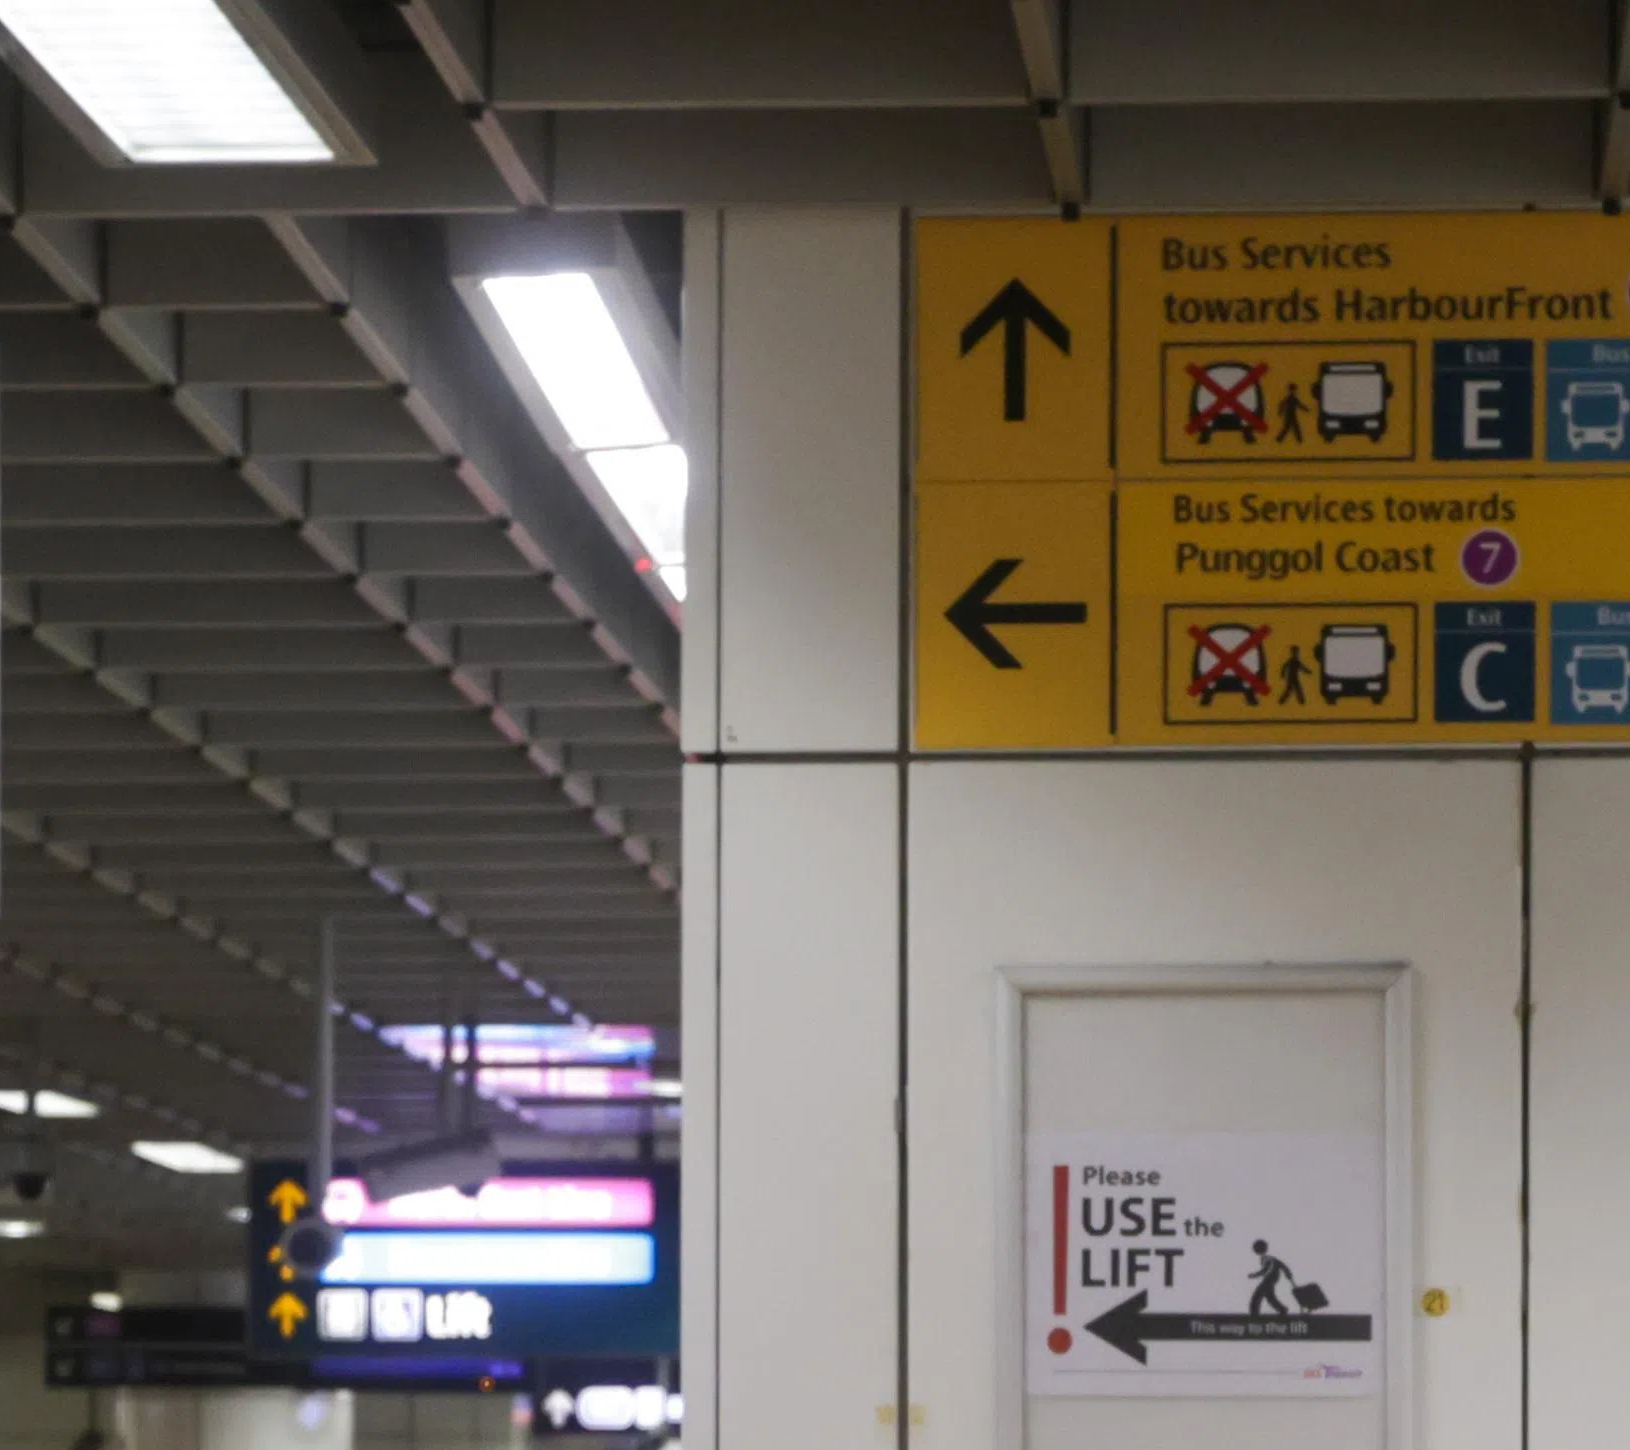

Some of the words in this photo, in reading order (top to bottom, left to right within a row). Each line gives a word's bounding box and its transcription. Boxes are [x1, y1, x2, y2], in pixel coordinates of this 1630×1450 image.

[1161, 237, 1228, 271] Bus
[1240, 232, 1392, 270] Services
[1163, 286, 1321, 323] towards
[1334, 285, 1613, 322] HarbourFront
[1464, 343, 1500, 364] Exit
[1592, 344, 1630, 363] Bus
[1463, 380, 1502, 449] E
[1173, 495, 1231, 523] Bus
[1241, 493, 1375, 523] Services
[1384, 493, 1516, 523] towards
[1176, 541, 1323, 580] Punggol
[1335, 541, 1435, 573] Coast
[1479, 541, 1502, 575] 7
[1467, 607, 1502, 626] Exit
[1460, 641, 1507, 712] C
[1082, 1165, 1161, 1186] Please
[1081, 1197, 1176, 1237] USE
[1184, 1216, 1225, 1237] the
[1081, 1248, 1185, 1287] LIFT
